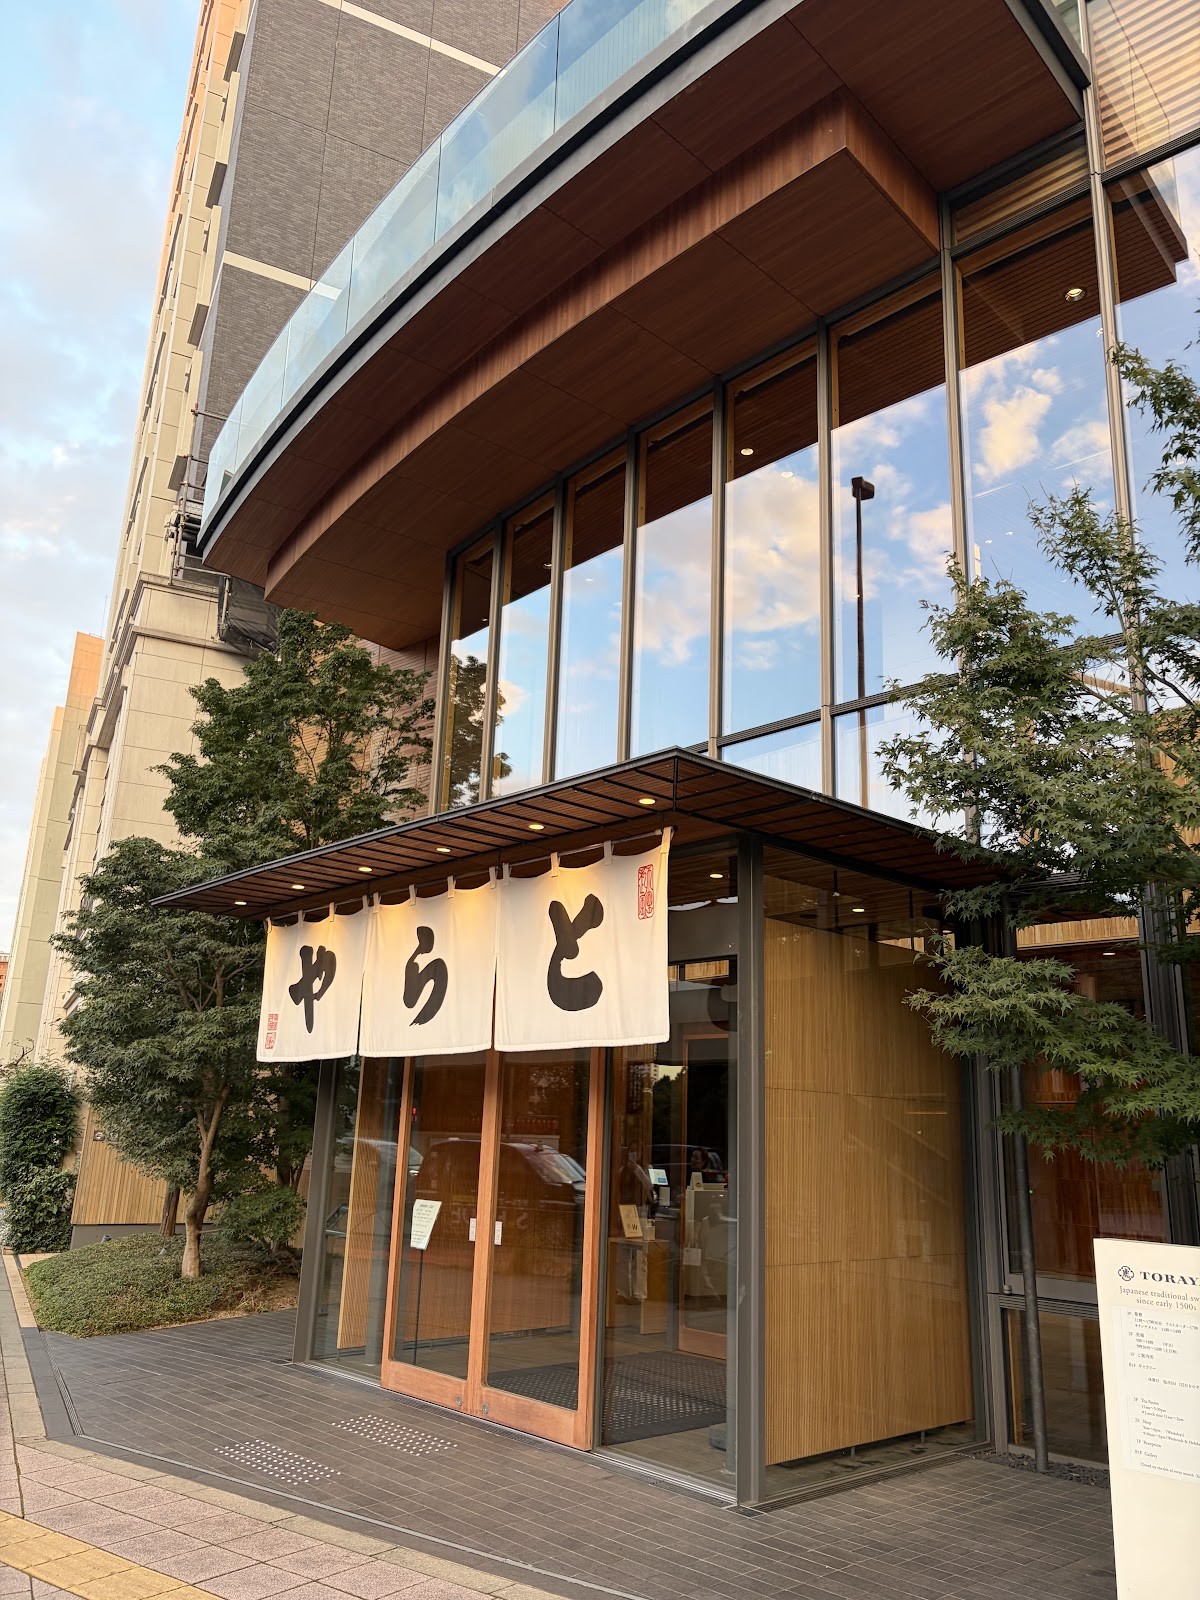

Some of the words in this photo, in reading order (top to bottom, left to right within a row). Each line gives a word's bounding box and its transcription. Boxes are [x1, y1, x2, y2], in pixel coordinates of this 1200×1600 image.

[1140, 1272, 1200, 1286] TORAY
[1120, 1286, 1148, 1296] Japanese
[1151, 1290, 1188, 1300] traditional
[1156, 1301, 1173, 1310] early
[1176, 1302, 1197, 1310] 1500s
